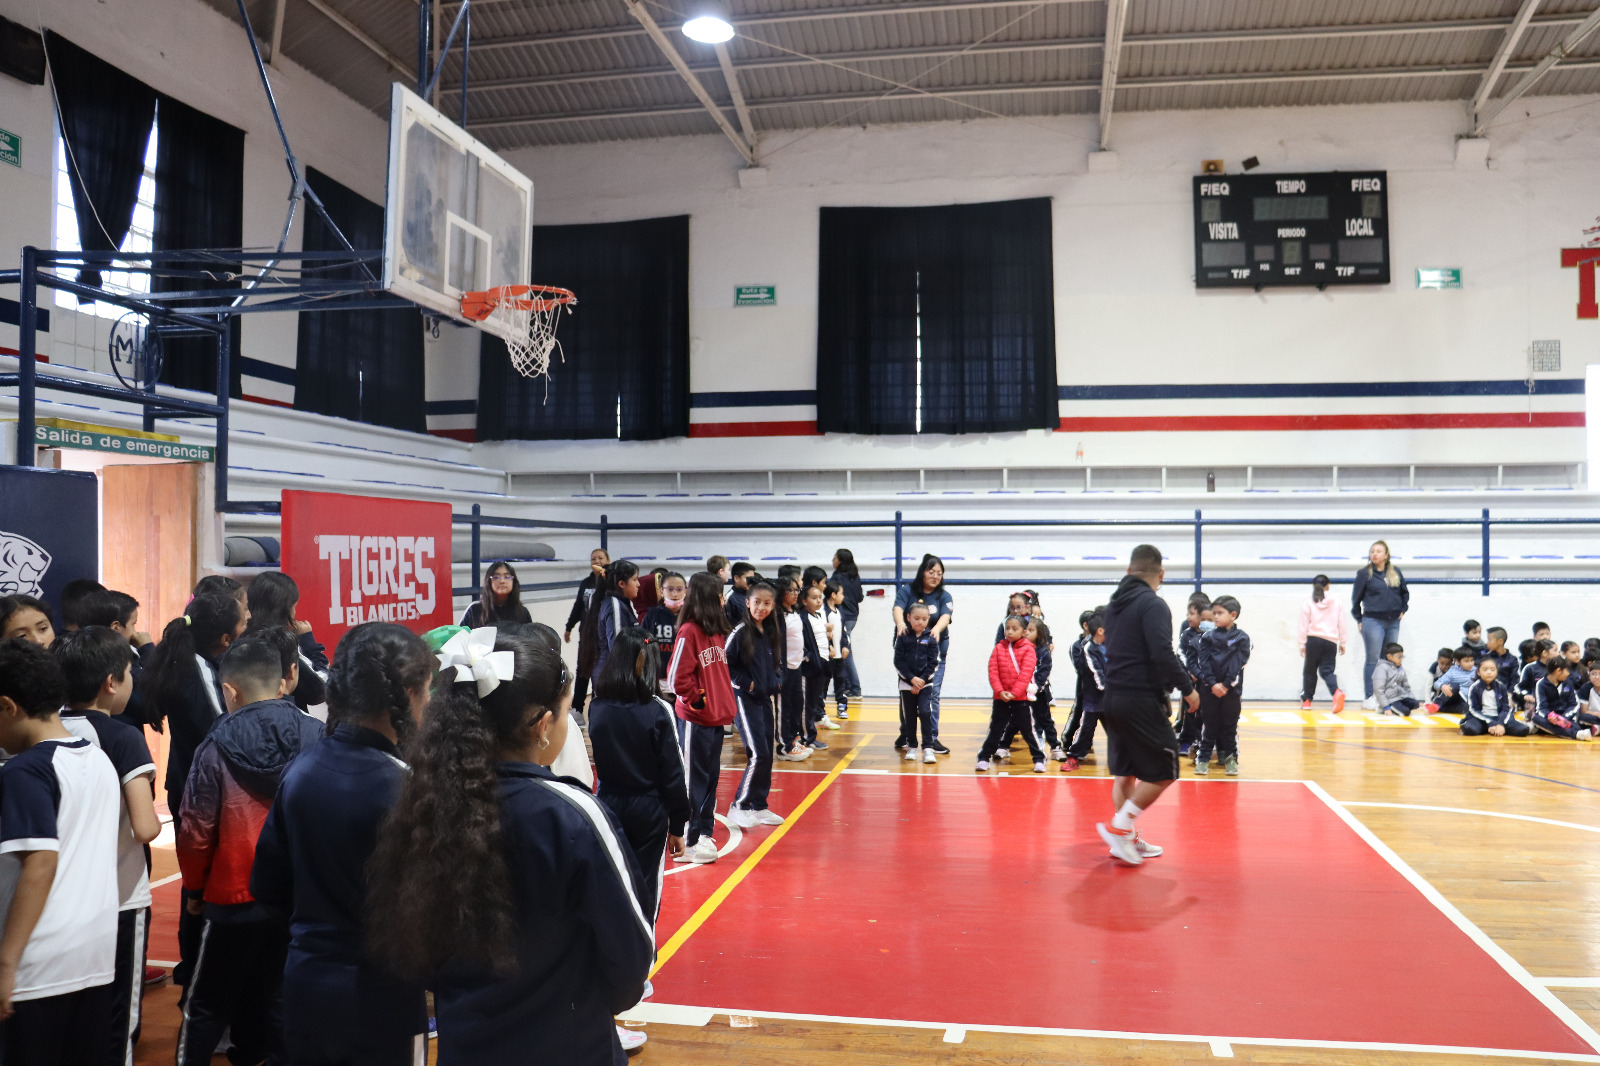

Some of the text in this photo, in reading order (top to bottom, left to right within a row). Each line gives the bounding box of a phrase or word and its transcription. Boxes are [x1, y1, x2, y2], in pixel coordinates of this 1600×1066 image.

[1200, 182, 1230, 196] F/EQ
[1275, 180, 1306, 194] TIEMPO
[1351, 178, 1381, 192] F/EQ
[1208, 222, 1239, 240] VISITA
[1277, 228, 1306, 238] PERIODO
[1345, 218, 1374, 236] LOCAL
[1231, 268, 1251, 279] T/F
[1284, 267, 1301, 276] SET
[1335, 266, 1355, 277] T/F
[35, 426, 210, 459] Salida de emergencia
[318, 534, 436, 625] TIGRES
[346, 602, 417, 627] BLANCOS
